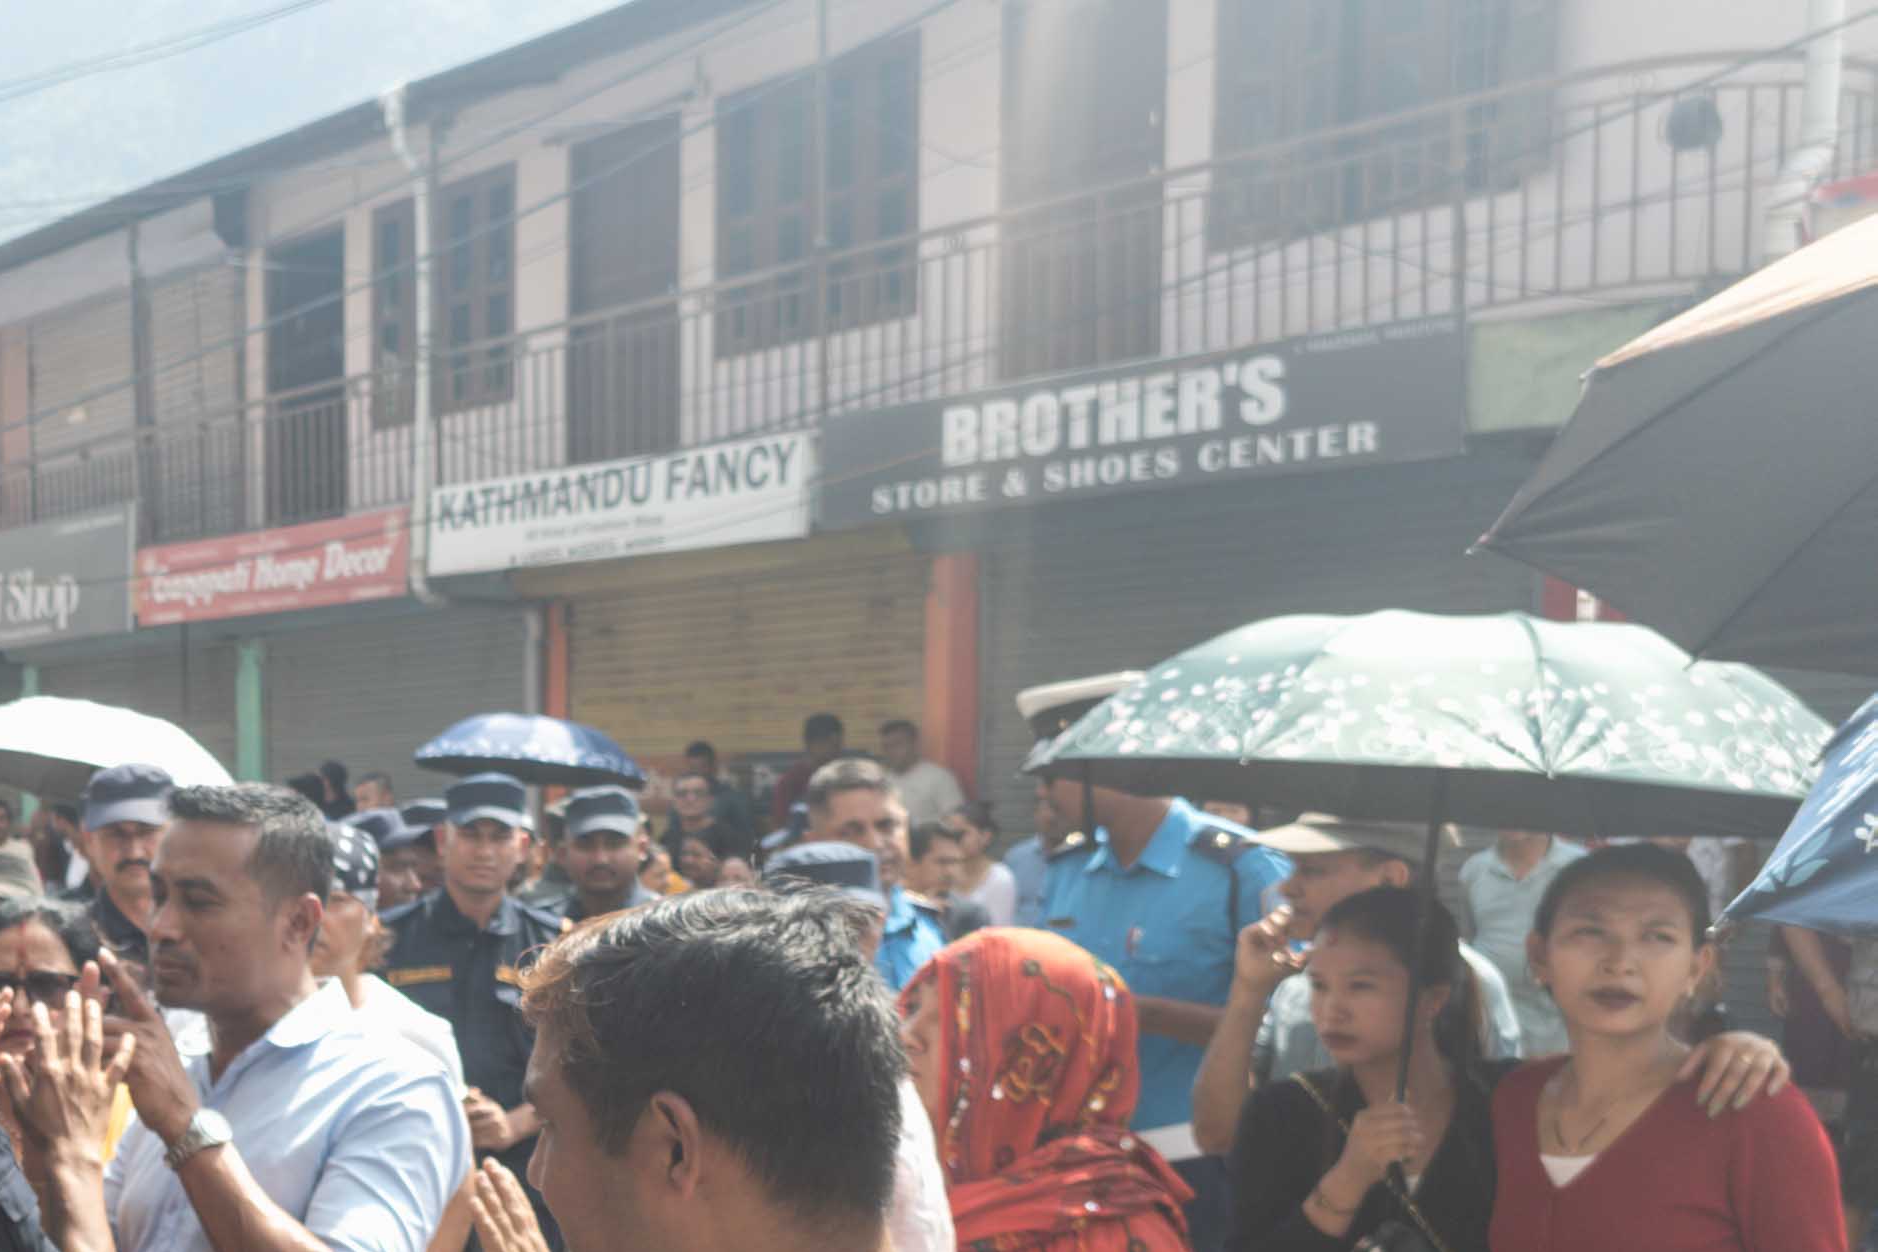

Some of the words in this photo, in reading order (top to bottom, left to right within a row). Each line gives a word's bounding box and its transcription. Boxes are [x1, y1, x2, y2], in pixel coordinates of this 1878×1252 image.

[941, 355, 1287, 467] BROTHER'S
[437, 461, 653, 532] KATHMANDU
[664, 440, 798, 502] FANCY
[871, 469, 987, 514] STORE
[1001, 468, 1027, 498] &
[1042, 446, 1180, 493] SHOES
[1197, 421, 1379, 473] CENTER
[5, 568, 81, 632] Shop
[323, 540, 394, 581] Decor
